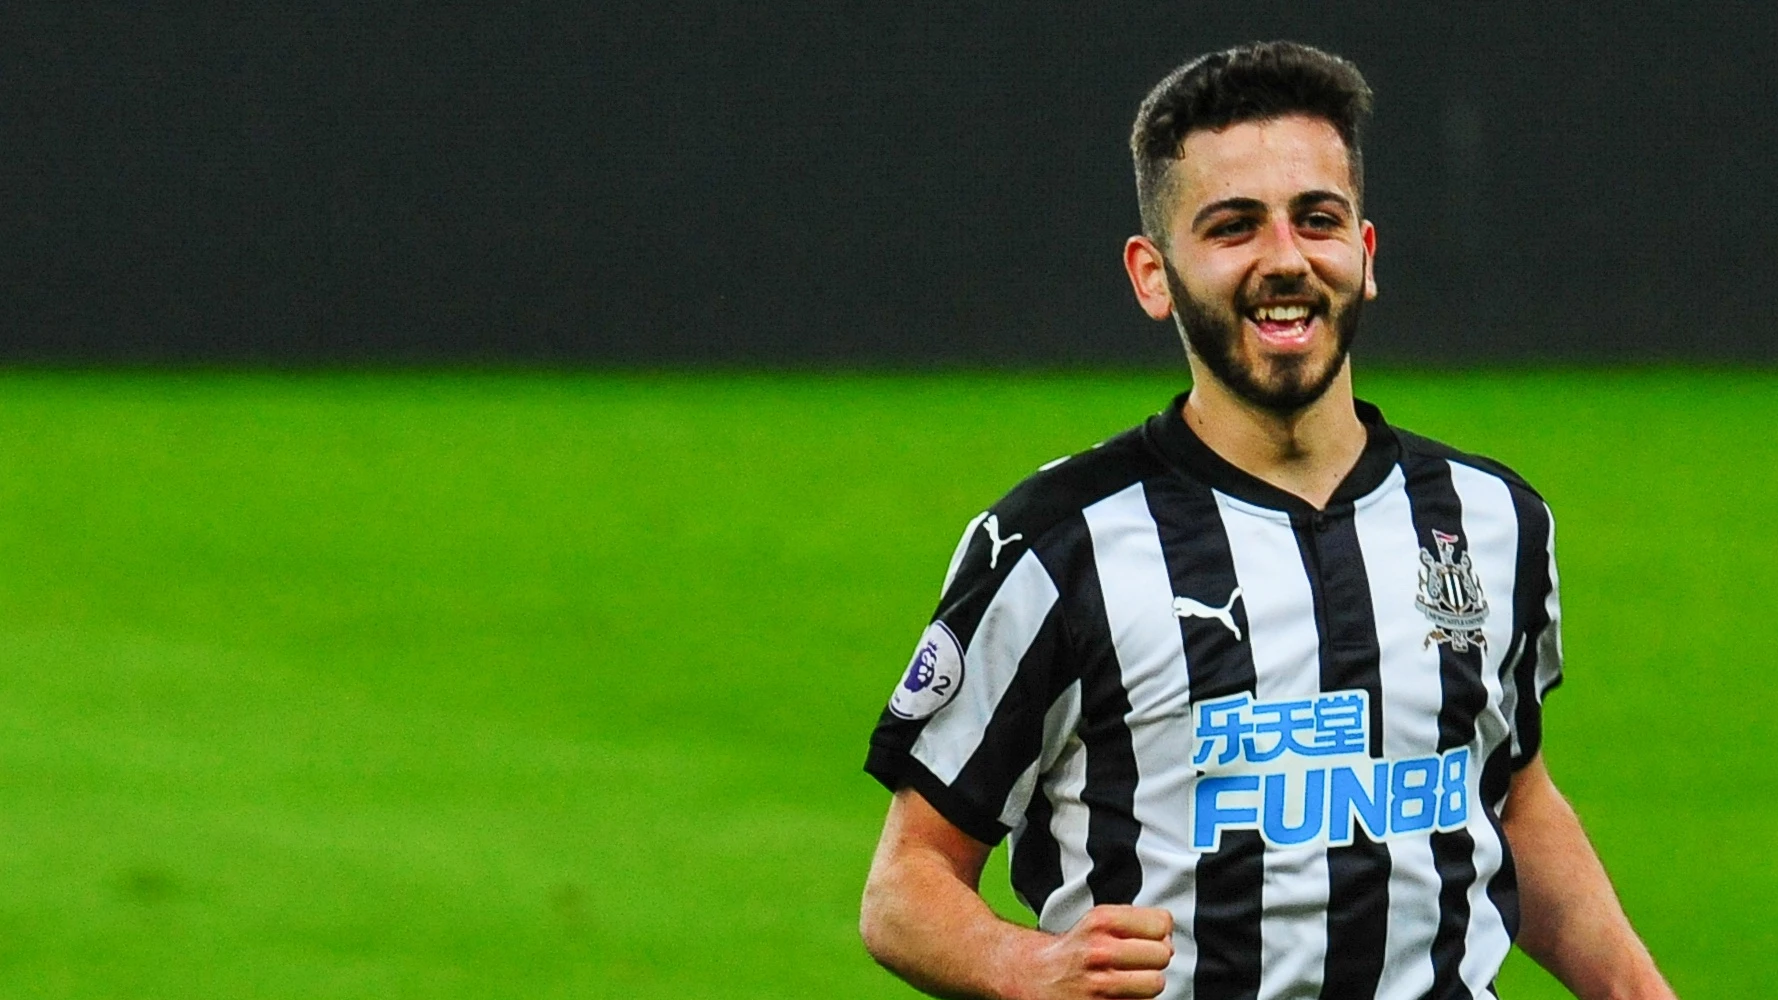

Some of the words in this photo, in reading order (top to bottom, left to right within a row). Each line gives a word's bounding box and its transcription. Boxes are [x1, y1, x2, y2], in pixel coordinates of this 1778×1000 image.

[931, 675, 952, 697] 2
[1193, 694, 1365, 765] 乐天堂
[1193, 748, 1469, 848] FUN88
